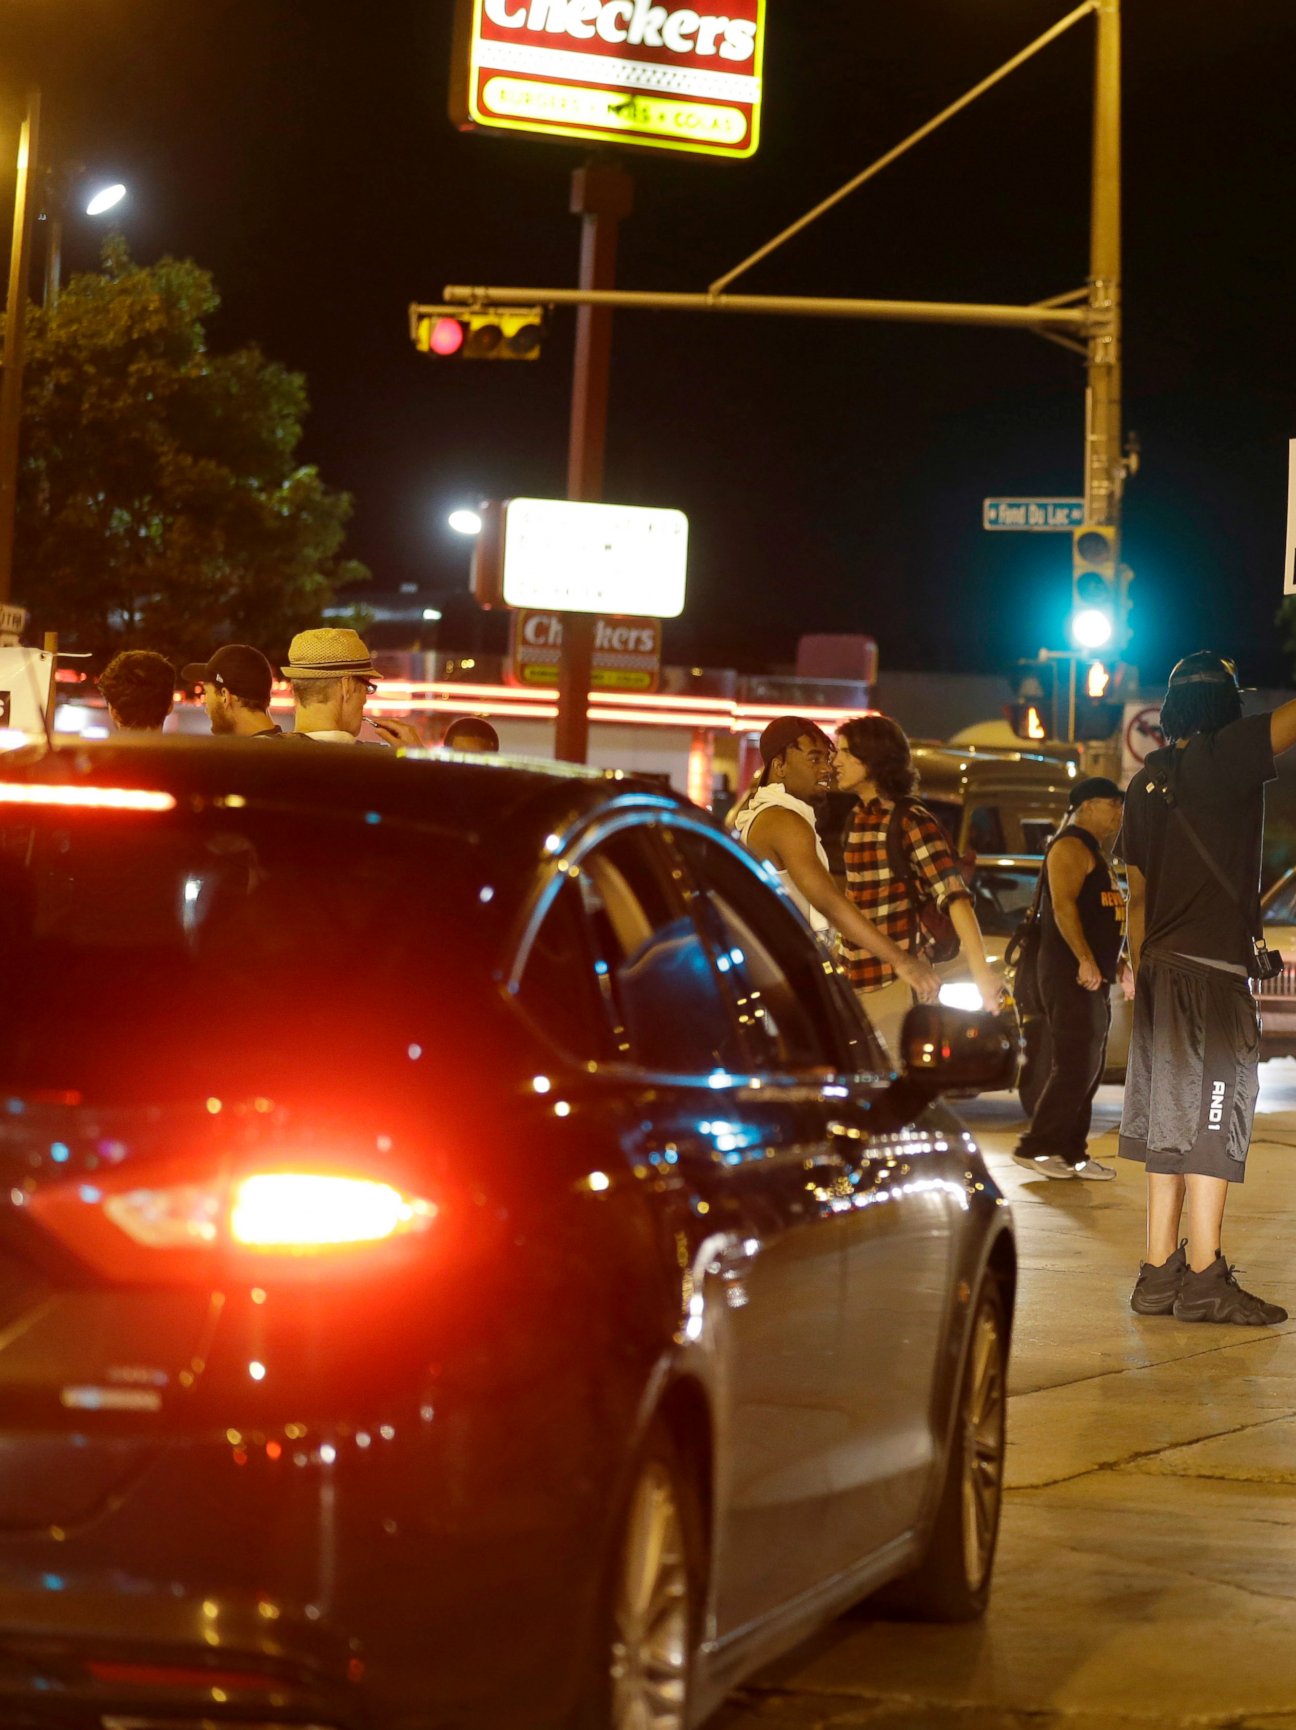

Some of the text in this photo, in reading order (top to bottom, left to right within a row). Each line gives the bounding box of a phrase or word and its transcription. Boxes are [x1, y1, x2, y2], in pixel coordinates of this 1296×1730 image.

[998, 503, 1026, 526] Fond
[1027, 503, 1046, 526] Du
[1047, 503, 1070, 526] Lac
[524, 614, 655, 652] Chkers
[1208, 1081, 1226, 1131] AND1
